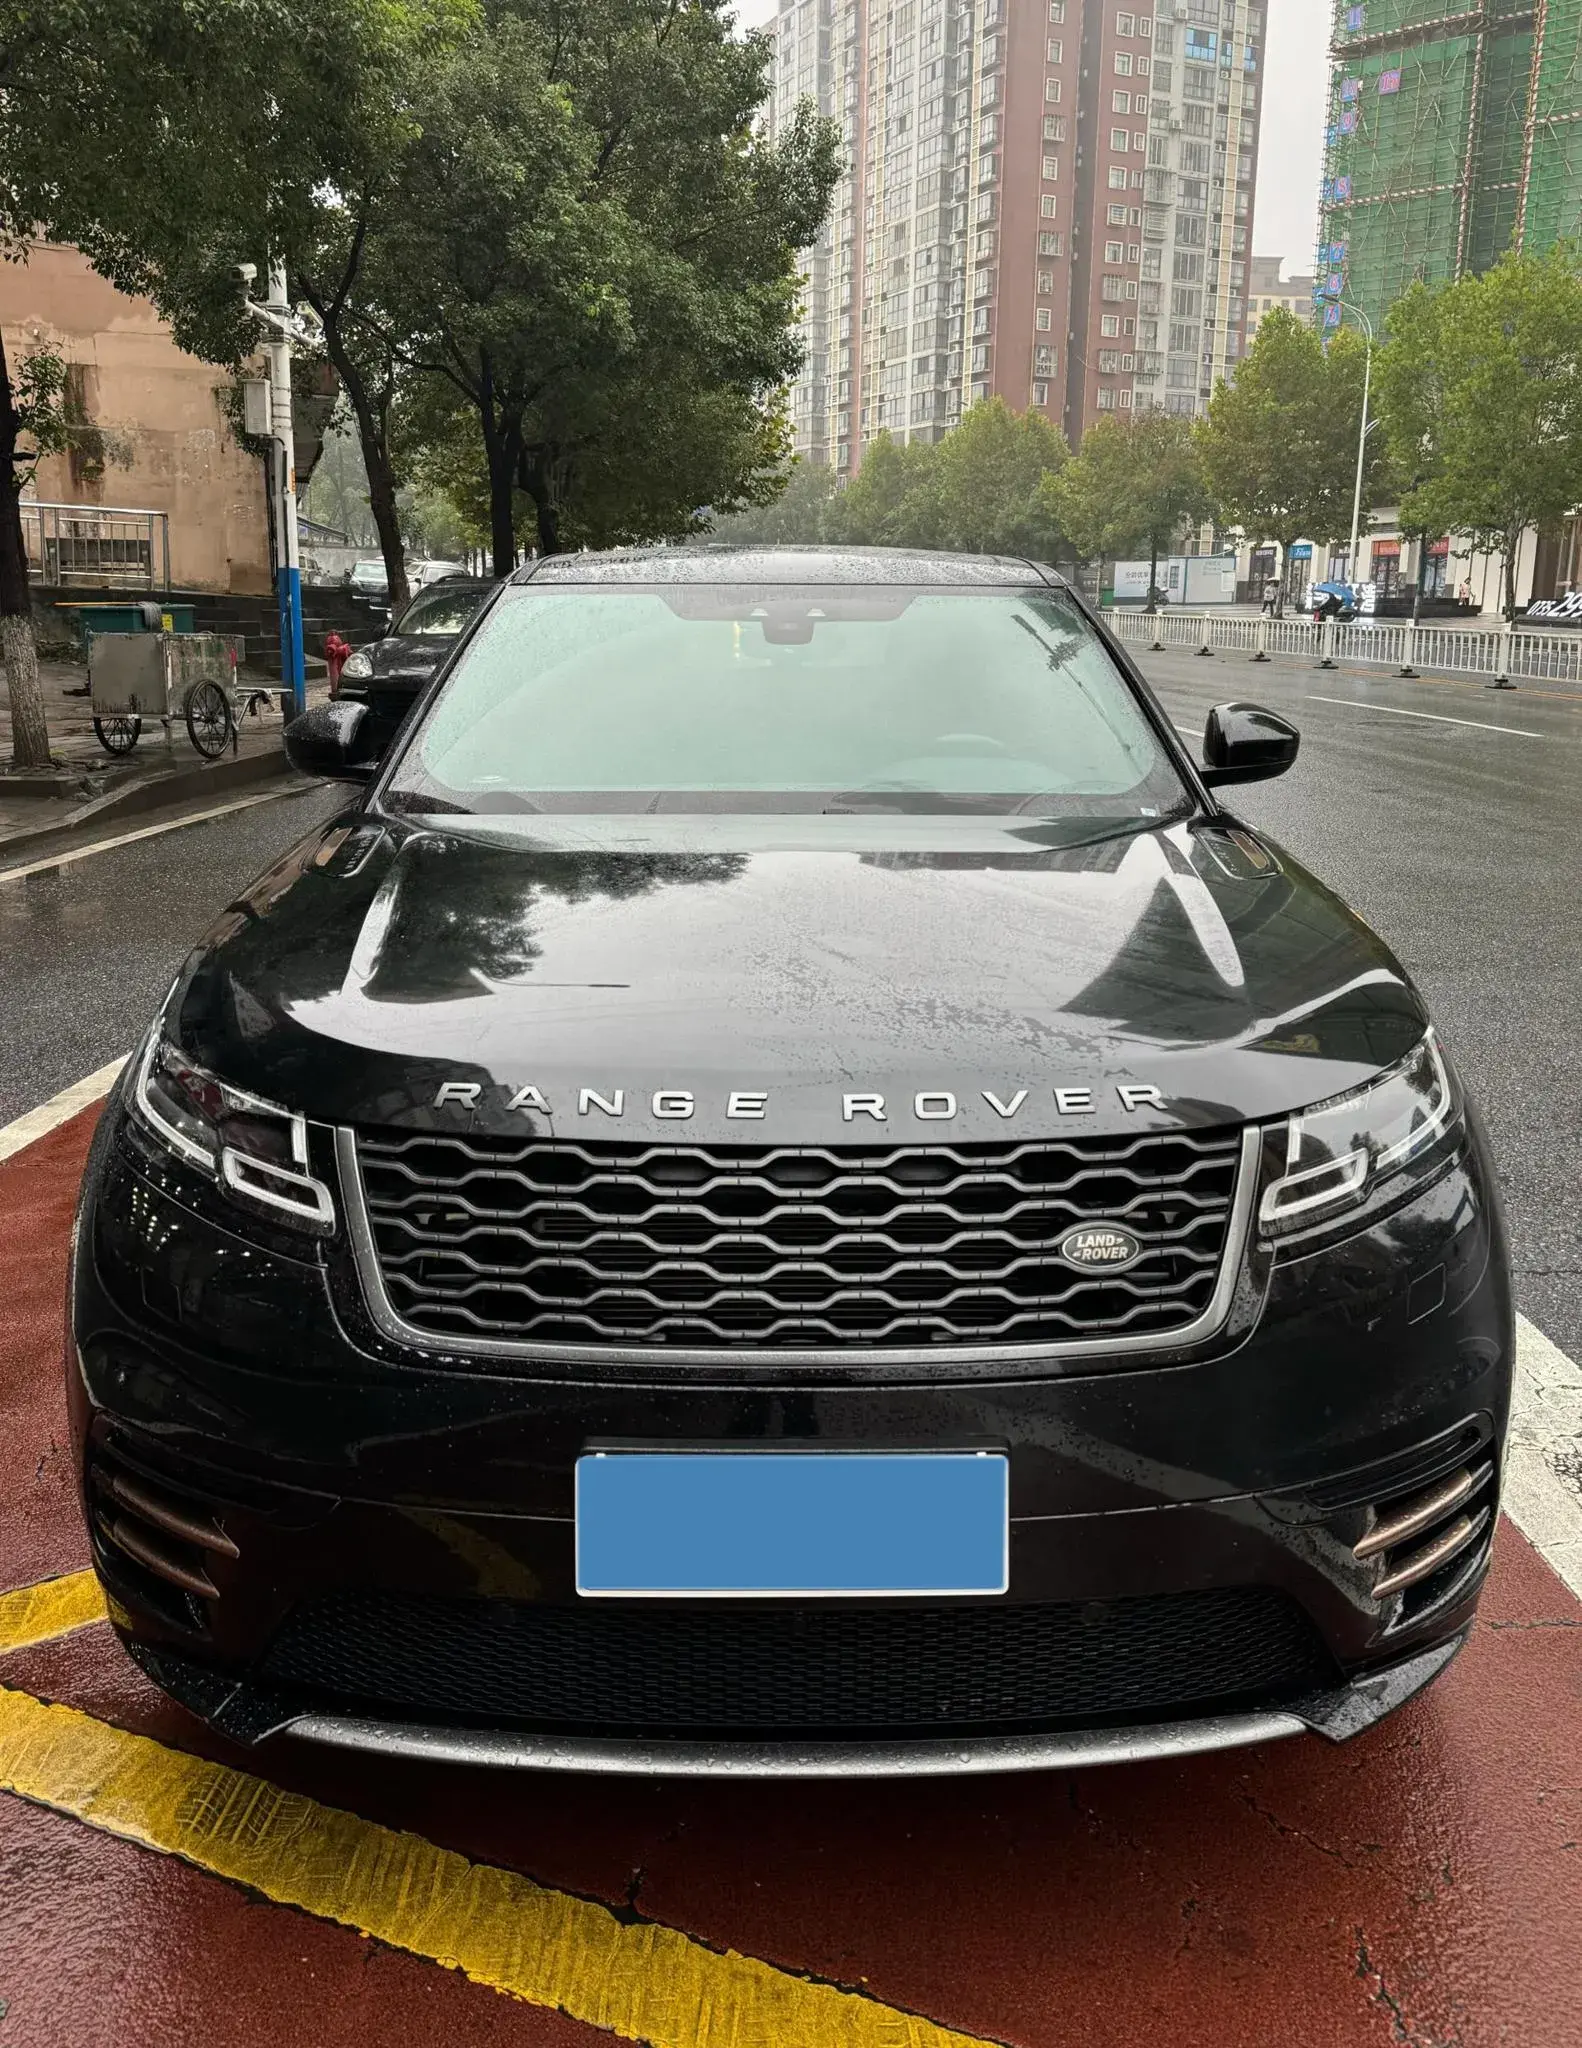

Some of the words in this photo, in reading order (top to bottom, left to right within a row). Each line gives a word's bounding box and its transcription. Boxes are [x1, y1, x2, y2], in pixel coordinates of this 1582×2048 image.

[433, 1082, 768, 1119] RANGE
[842, 1084, 1168, 1121] ROVER
[1077, 1234, 1116, 1248] LAND
[1081, 1246, 1128, 1260] ROVER
